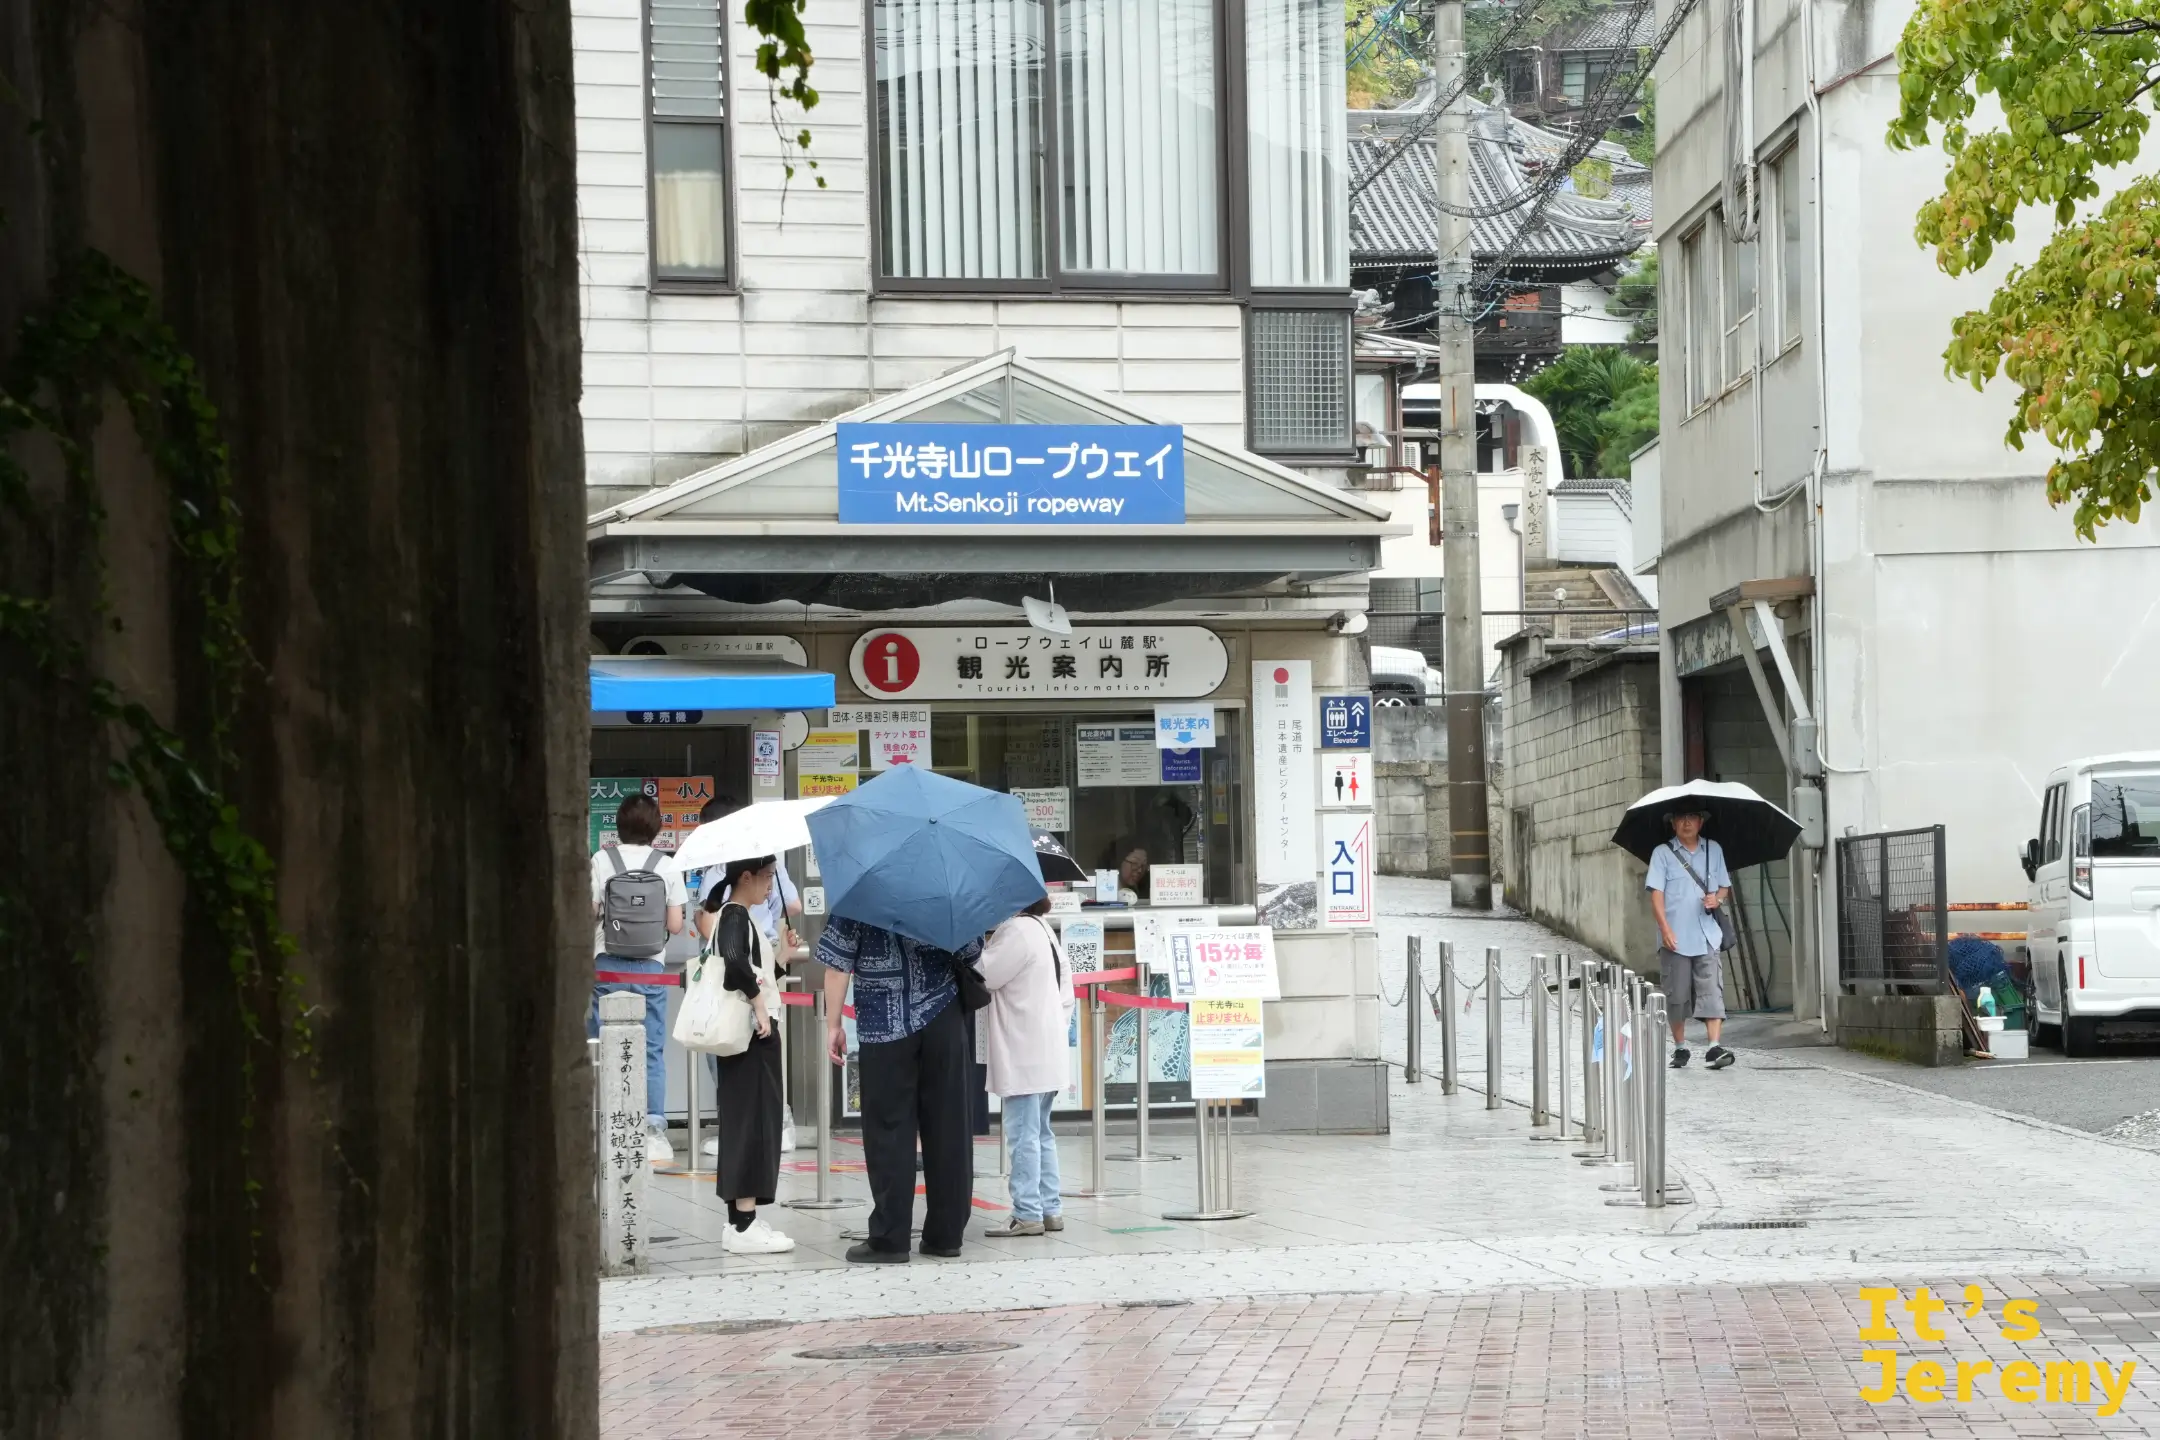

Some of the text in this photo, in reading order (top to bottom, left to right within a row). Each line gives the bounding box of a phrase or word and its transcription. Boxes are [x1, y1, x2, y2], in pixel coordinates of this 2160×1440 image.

[851, 441, 1173, 480] 千光寺山ロープウェイ
[896, 491, 1124, 516] Mt.Senkoji ropeway
[682, 642, 774, 650] ロープウェイ山麓駅
[975, 635, 1158, 650] ロープウェイ山麓駅
[957, 655, 1170, 680] 観光案内所
[977, 683, 1150, 692] Tourist Information
[643, 712, 686, 723] 券売機
[832, 711, 927, 723] 団体・各種割引専用窓口
[1160, 717, 1209, 730] 観光案内
[875, 730, 926, 739] チケット窓口
[1292, 719, 1302, 754] 尾道市
[883, 743, 918, 752] 現金のみ
[590, 781, 624, 799] 大人
[646, 785, 655, 795] 3
[677, 782, 711, 799] 小人
[1278, 719, 1289, 861] 日本遺産ビジターセンター
[1036, 806, 1053, 815] 500
[1331, 841, 1355, 895] 入口
[1156, 878, 1196, 888] 観光案内
[1196, 943, 1263, 963] 15分毎
[1208, 1000, 1244, 1009] 千光寺には
[627, 1110, 645, 1169] 妙宣寺
